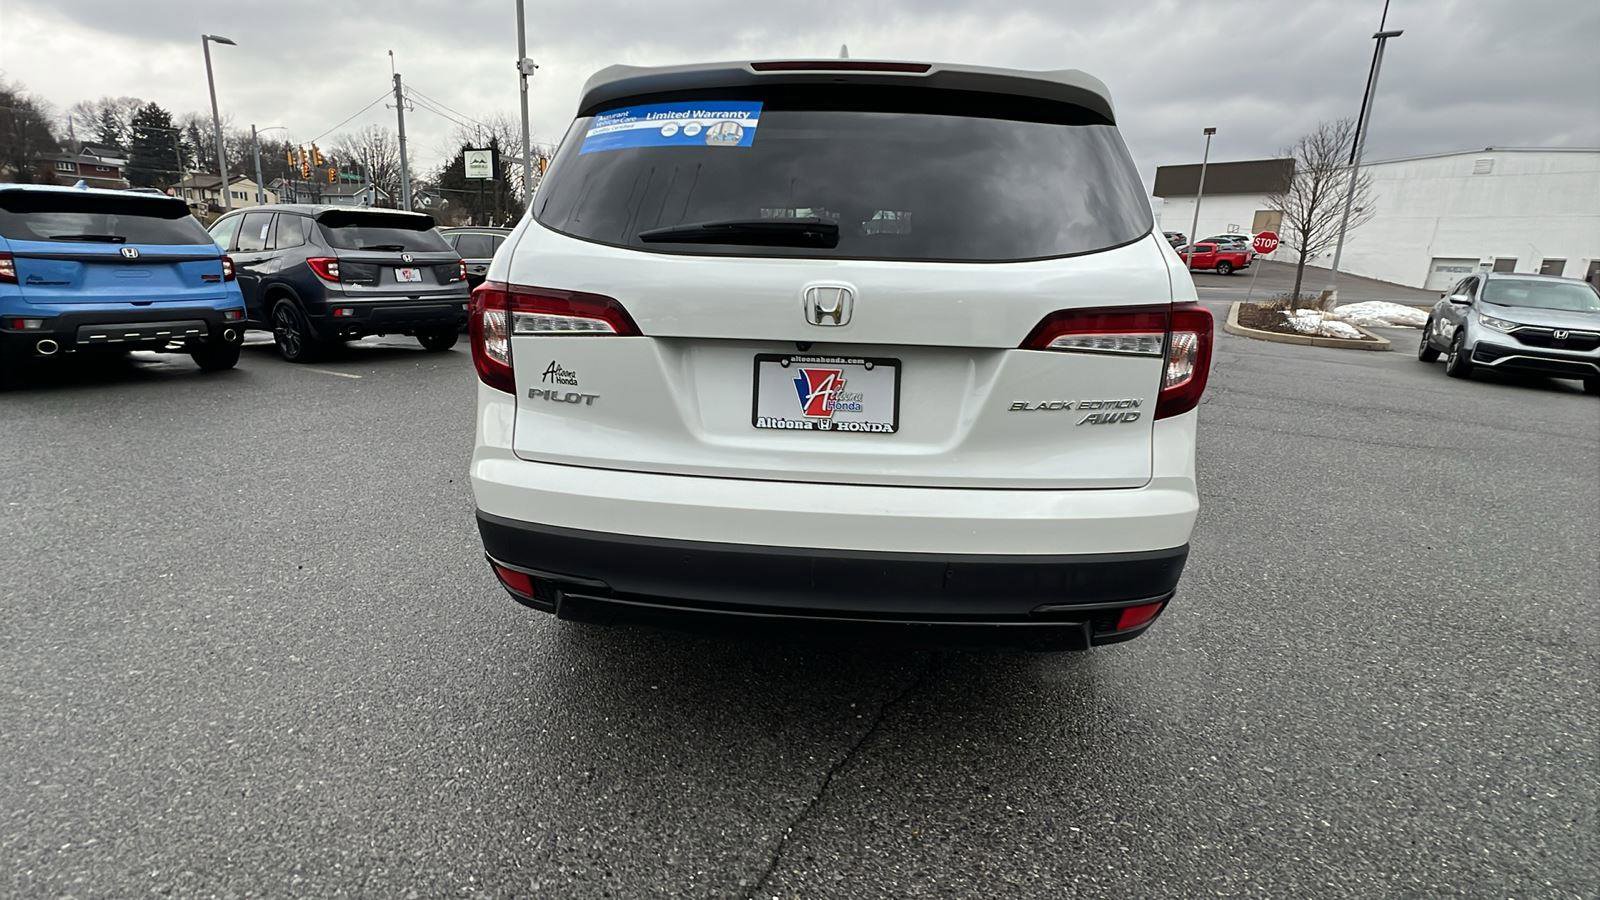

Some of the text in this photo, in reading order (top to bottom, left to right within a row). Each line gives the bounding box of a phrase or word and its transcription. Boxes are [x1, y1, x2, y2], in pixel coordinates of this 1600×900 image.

[646, 109, 751, 120] Limited Warranty
[1253, 237, 1278, 248] STOP
[790, 355, 865, 364] altoonahonda.com
[556, 376, 578, 386] Honda
[527, 388, 601, 406] PILOT
[827, 400, 862, 411] Honda
[1008, 398, 1144, 412] BLACK EDITION
[1075, 411, 1142, 427] AWD
[756, 417, 813, 430] Altoona
[837, 421, 894, 433] HONDA
